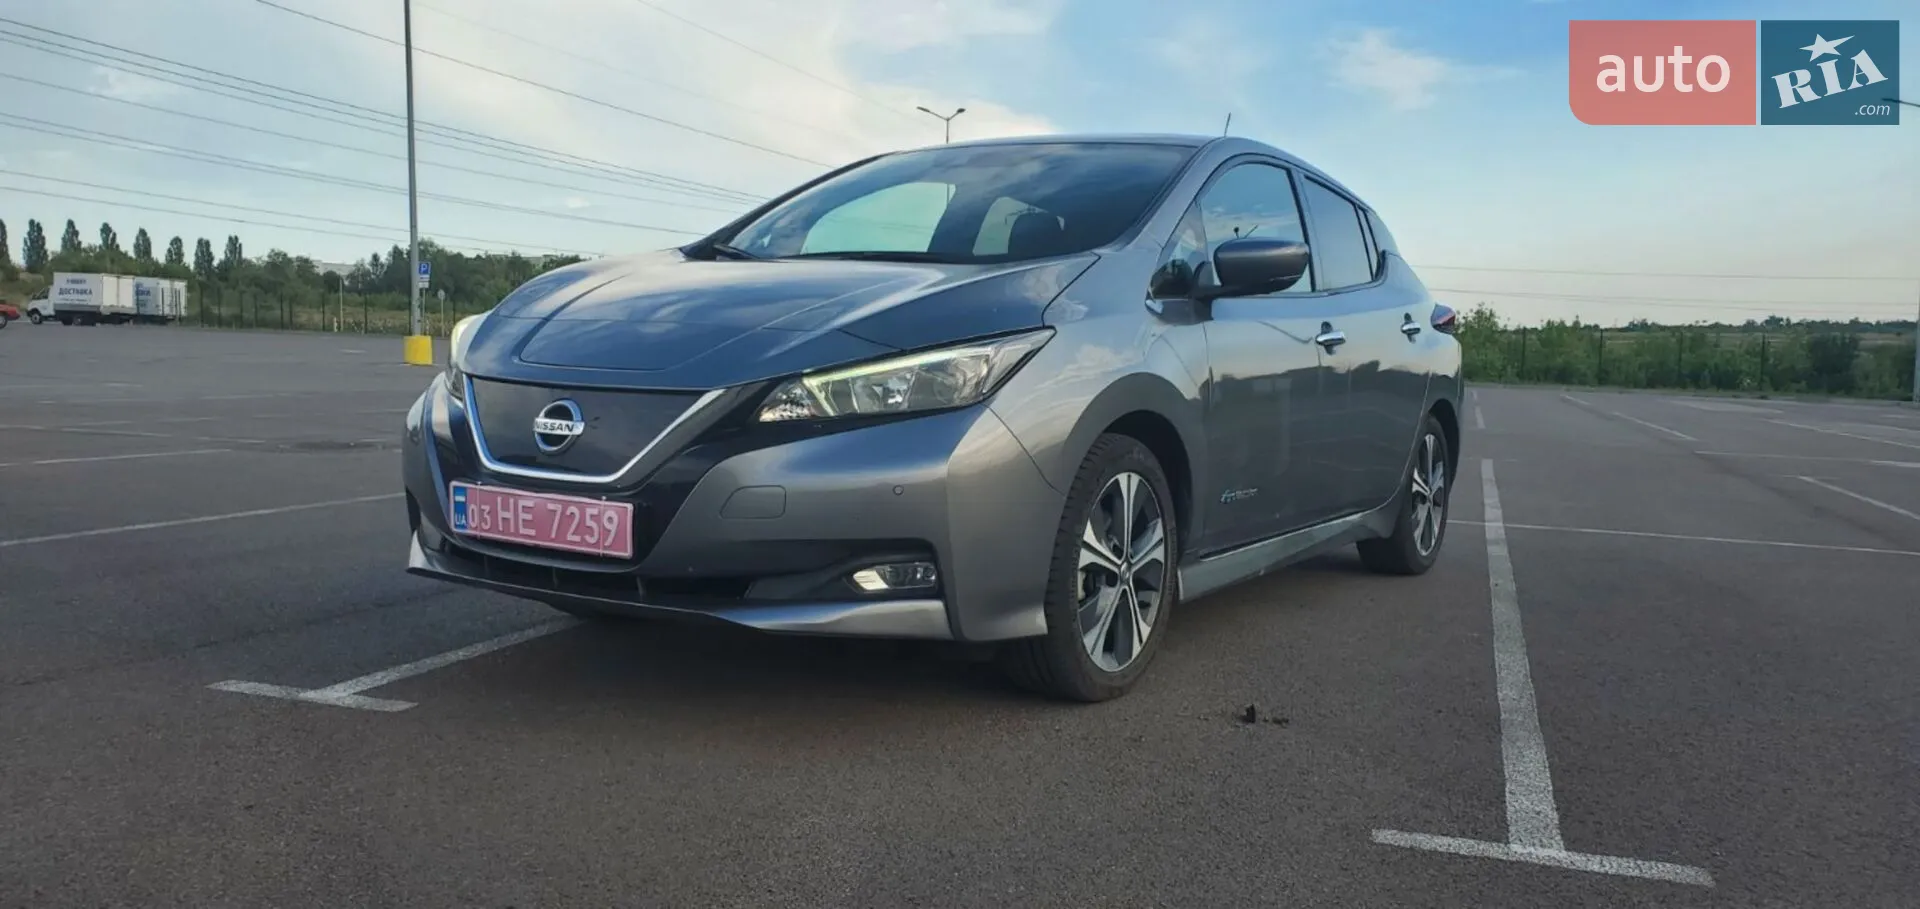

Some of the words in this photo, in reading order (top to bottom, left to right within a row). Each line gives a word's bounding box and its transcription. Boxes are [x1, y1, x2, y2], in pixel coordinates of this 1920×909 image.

[535, 420, 575, 433] NISSAN
[454, 514, 467, 527] UA
[468, 504, 492, 531] 03
[546, 502, 619, 547] 7259
